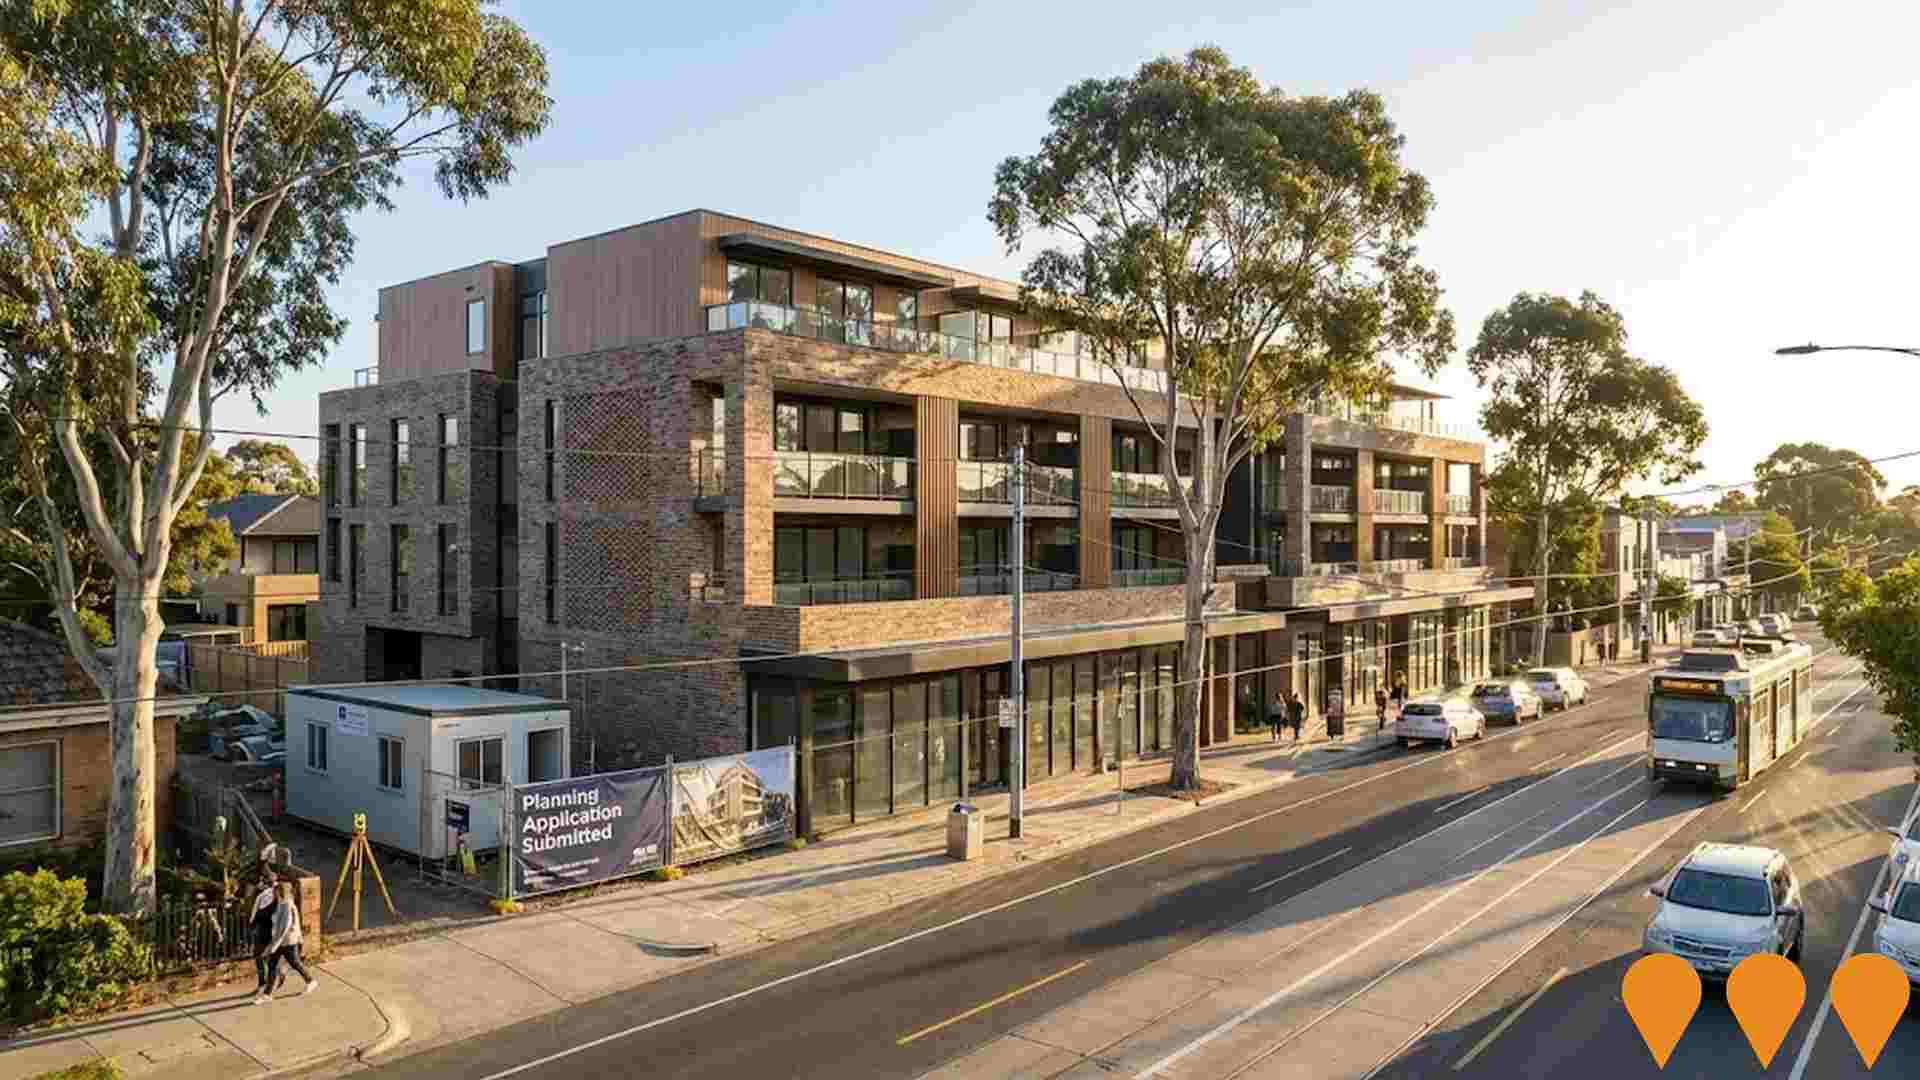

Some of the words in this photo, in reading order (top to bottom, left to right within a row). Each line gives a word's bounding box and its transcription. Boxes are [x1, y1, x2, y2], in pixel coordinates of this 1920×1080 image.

[523, 788, 599, 811] Planning
[523, 805, 622, 833] Application
[522, 824, 612, 853] Submitted
